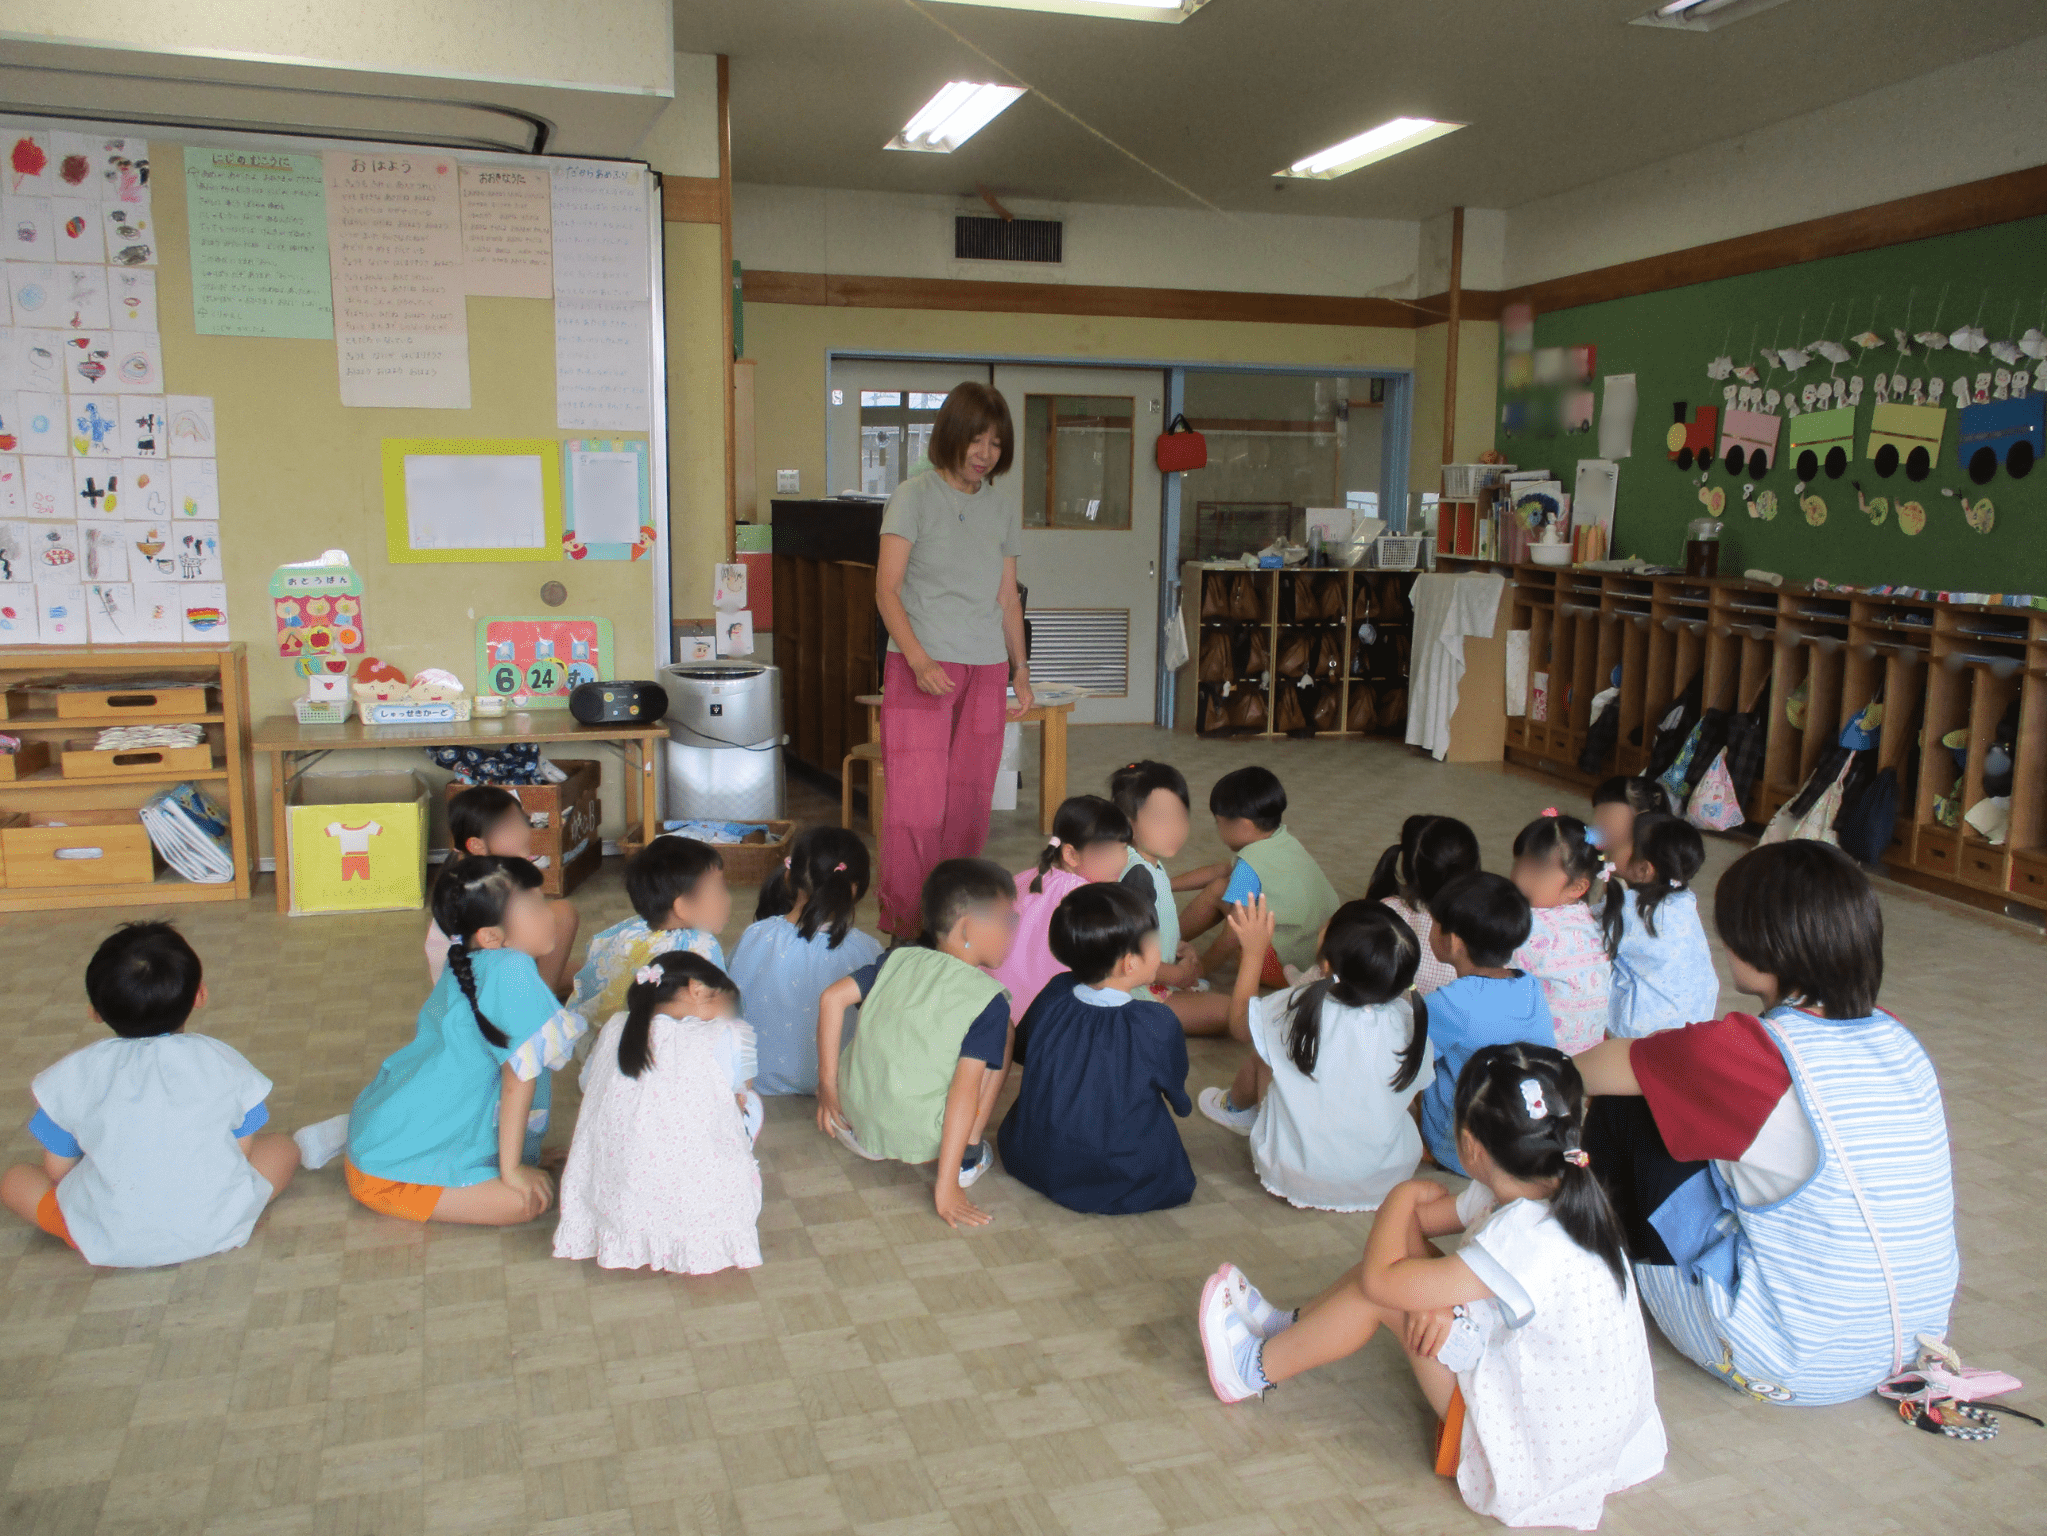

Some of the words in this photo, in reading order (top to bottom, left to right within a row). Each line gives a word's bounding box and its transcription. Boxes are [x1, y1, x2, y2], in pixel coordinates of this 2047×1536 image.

[212, 154, 291, 166] にじのむこうに
[351, 159, 412, 173] おはよう
[288, 576, 348, 586] おとうばん
[496, 668, 515, 692] 6
[531, 669, 554, 689] 24
[381, 709, 449, 718] しゅっせきかーど
